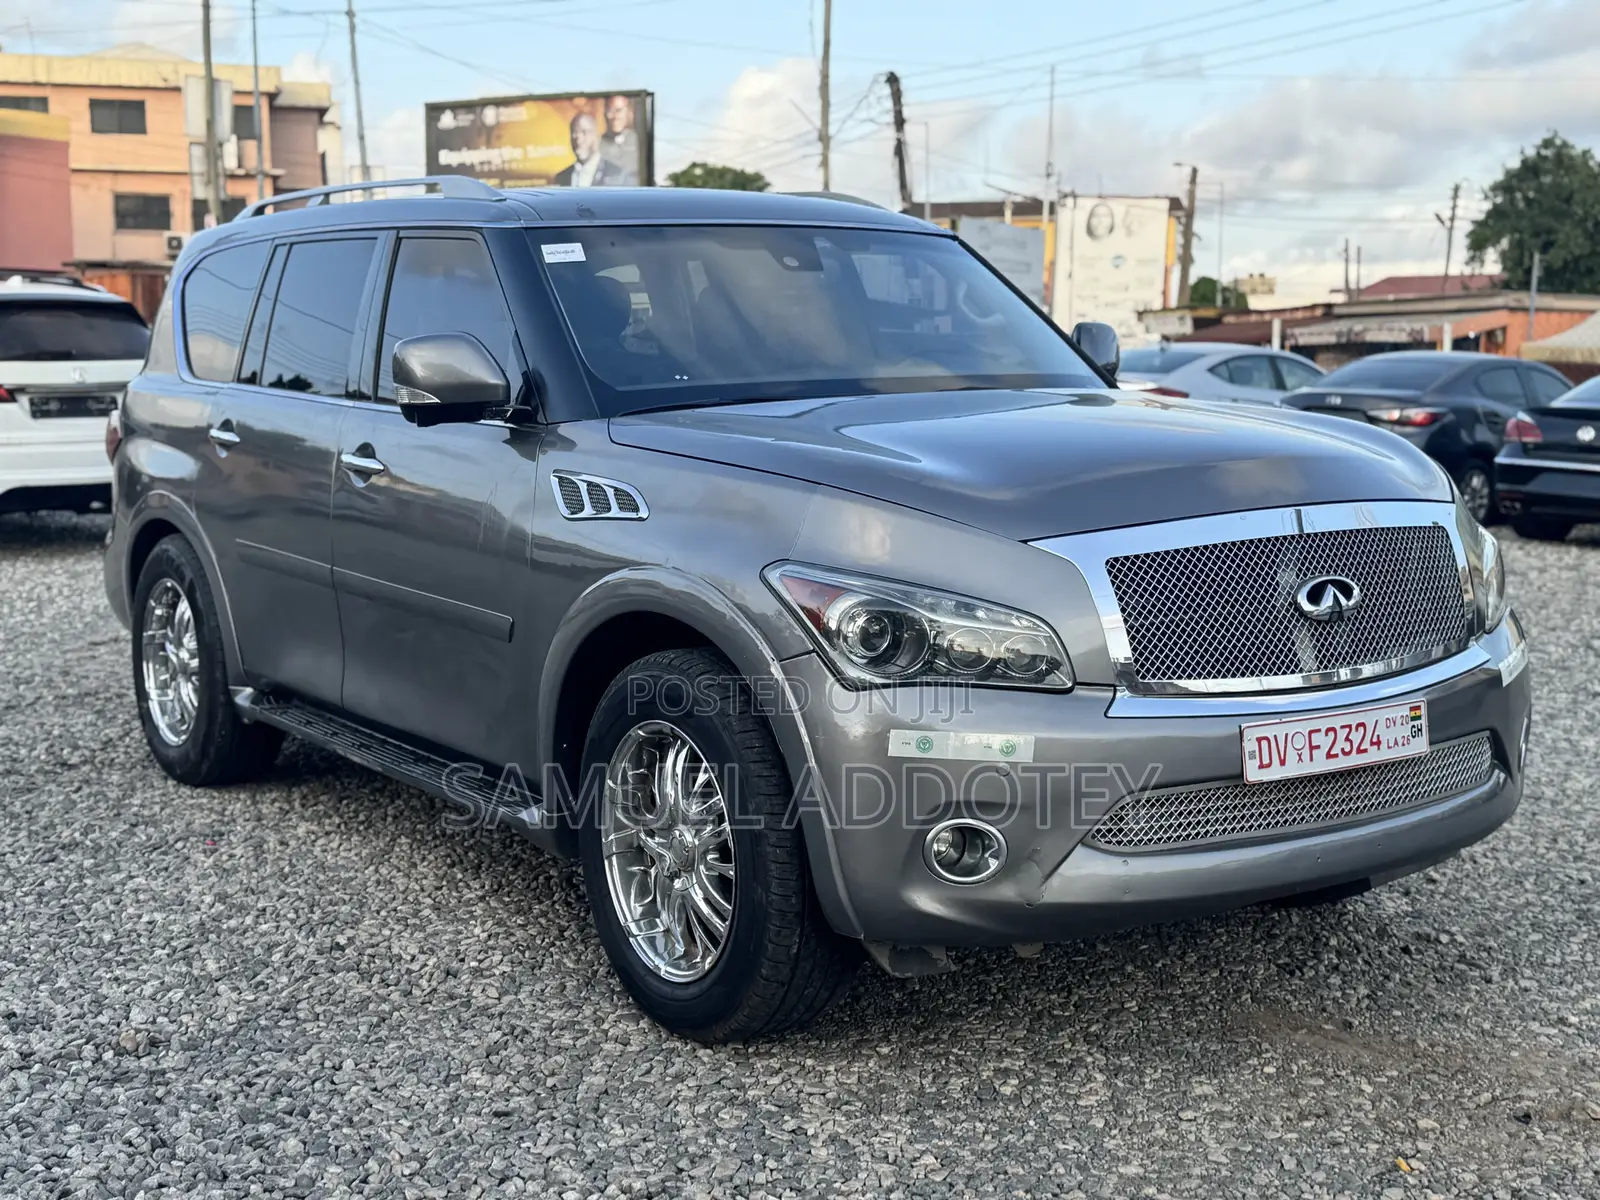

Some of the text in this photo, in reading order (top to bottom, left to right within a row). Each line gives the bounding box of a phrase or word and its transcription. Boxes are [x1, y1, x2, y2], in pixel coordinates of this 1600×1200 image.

[1385, 713, 1410, 729] DV 20
[1410, 723, 1423, 739] GH
[1256, 732, 1289, 770] DV
[1308, 719, 1382, 762] F2324
[1387, 737, 1399, 750] LA
